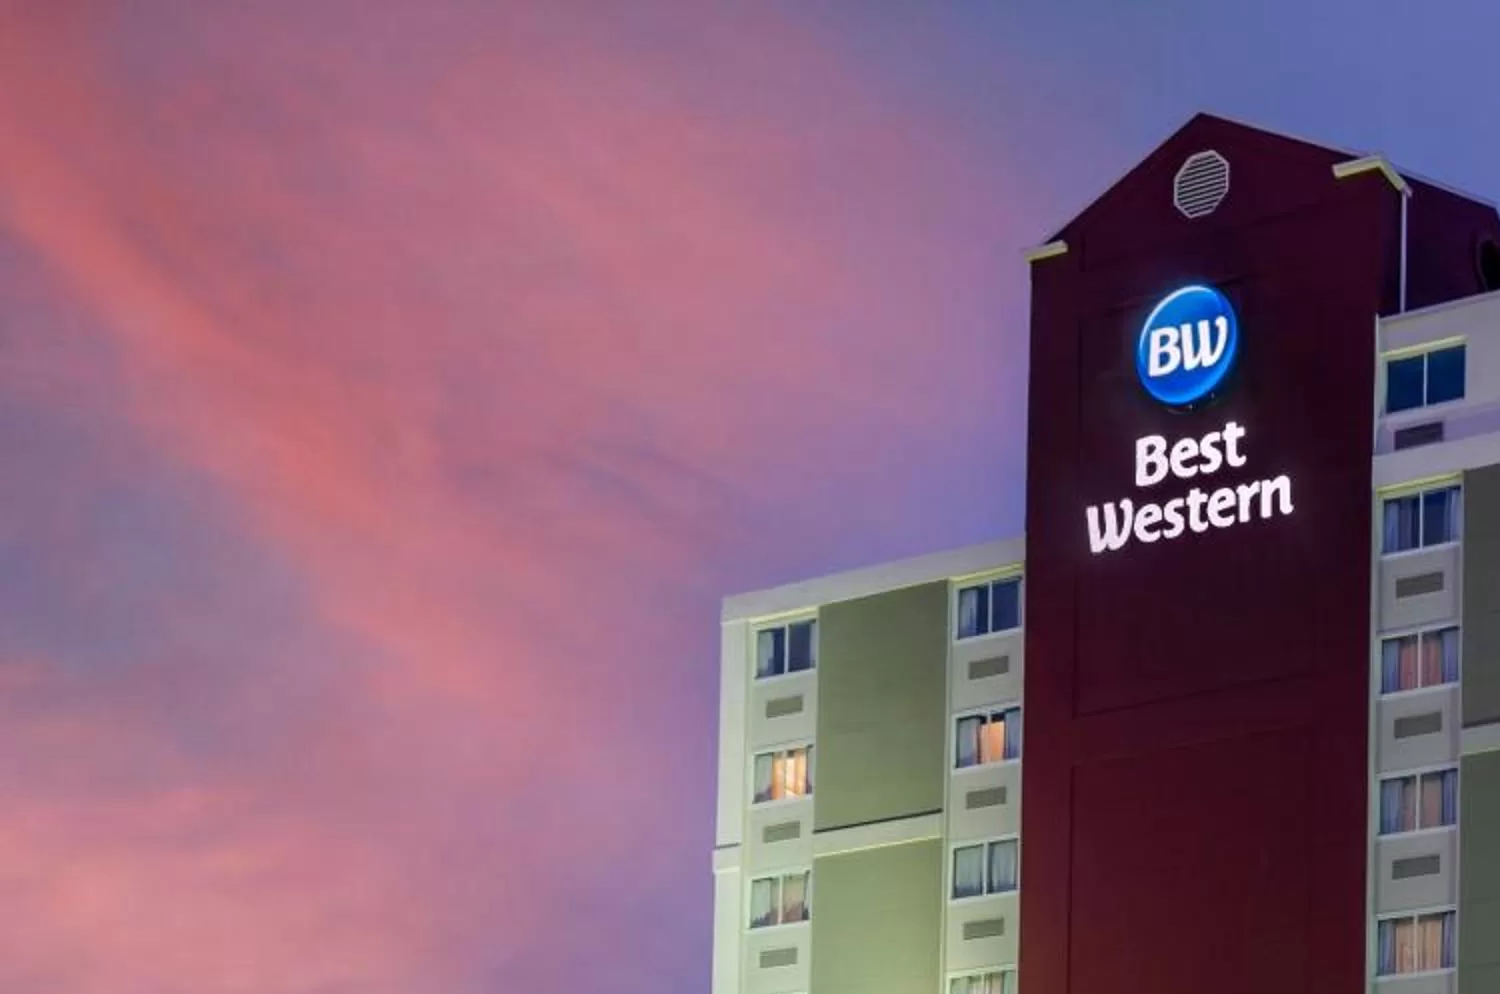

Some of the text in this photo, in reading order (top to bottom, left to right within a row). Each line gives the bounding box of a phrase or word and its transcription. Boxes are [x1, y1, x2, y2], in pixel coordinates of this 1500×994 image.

[1148, 316, 1228, 377] BW
[1135, 421, 1247, 487] Best
[1086, 475, 1294, 553] Western
